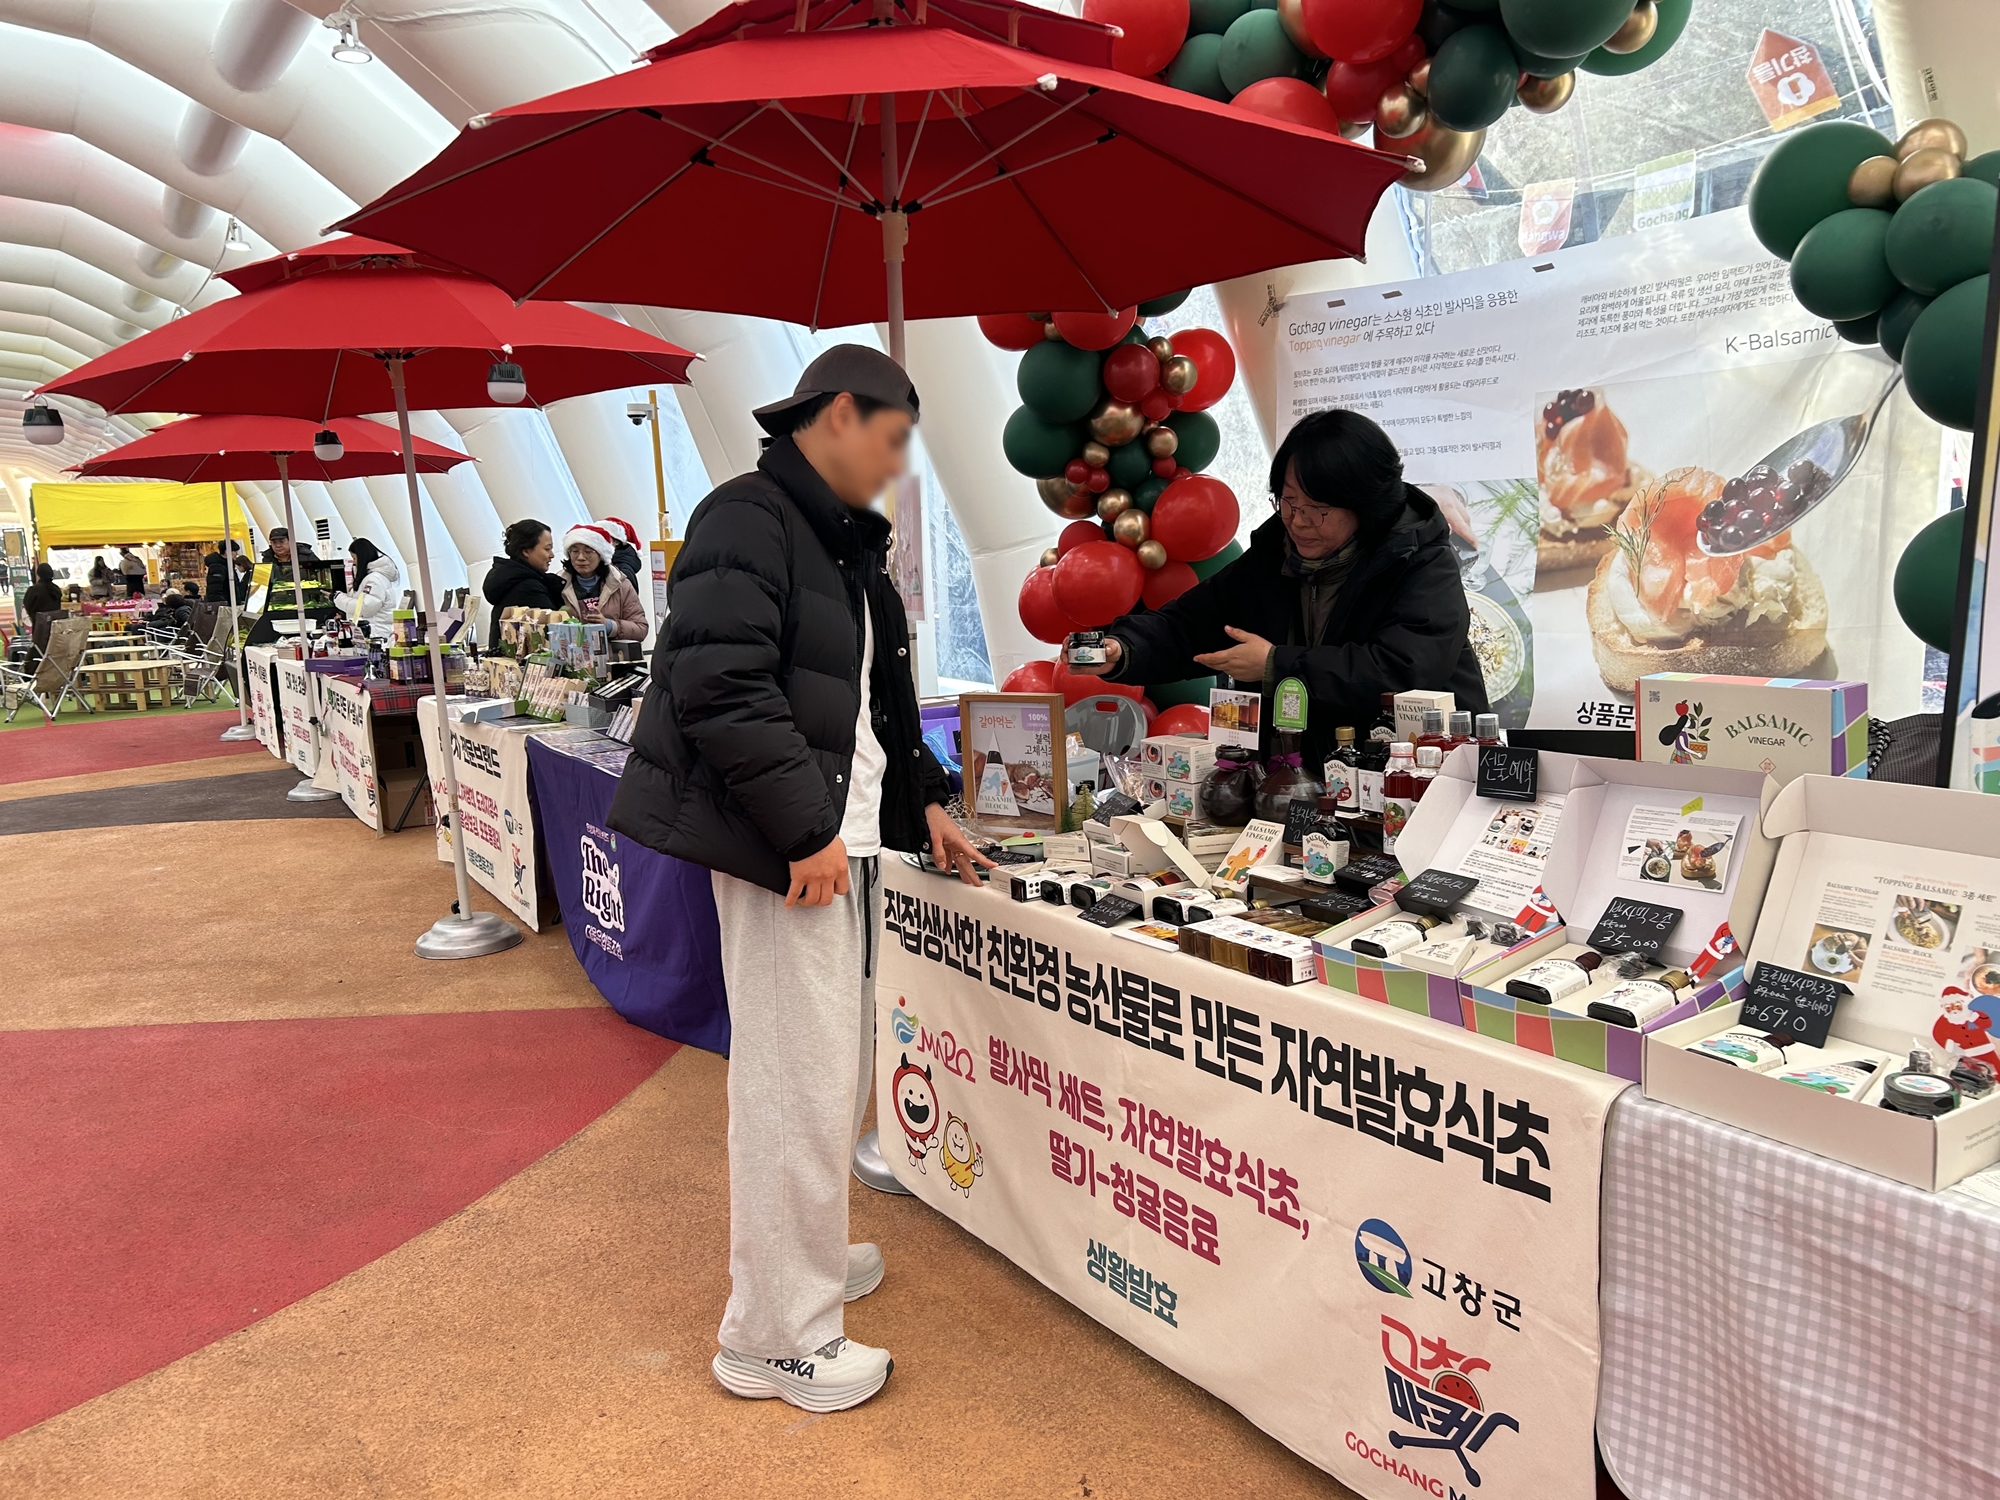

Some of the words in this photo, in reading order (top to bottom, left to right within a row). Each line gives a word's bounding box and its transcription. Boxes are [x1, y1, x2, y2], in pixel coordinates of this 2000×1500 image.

[1752, 45, 1813, 84] 참기름
[1637, 207, 1690, 229] Gochang
[1579, 304, 1600, 316] 요리에
[1688, 287, 1695, 298] 및
[1697, 285, 1713, 296] 생선
[1734, 277, 1750, 288] 야채
[1751, 274, 1767, 285] 또는
[1768, 269, 1785, 281] 과일
[1609, 286, 1637, 299] 비슷하게
[1639, 283, 1654, 295] 생긴
[1696, 271, 1719, 282] 우아한
[1722, 264, 1753, 279] 임팩트가
[1755, 260, 1771, 273] 있어
[1384, 309, 1411, 323] 소스형
[1415, 302, 1442, 319] 식초인
[1445, 295, 1485, 314] 발사믹을
[1487, 289, 1518, 307] 응용한
[1622, 309, 1643, 321] 풍미와
[1702, 294, 1725, 307] 그러나
[1727, 290, 1742, 302] 가장
[1744, 285, 1767, 298] 맛있게
[1769, 282, 1785, 293] 먹는
[1323, 333, 1361, 348] vinegar
[1363, 331, 1374, 342] 에
[1375, 325, 1413, 342] 주목하고
[1415, 321, 1435, 337] 있다
[1600, 324, 1621, 335] 치즈에
[1639, 319, 1653, 329] 먹는
[1680, 310, 1696, 321] 또한
[1725, 322, 1834, 354] K-Balsamic
[1028, 713, 1048, 722] 100%
[1398, 713, 1425, 722] VINEGA
[1577, 701, 1636, 728] 상품문
[1371, 728, 1396, 741] BALSAMIC
[1724, 713, 1814, 748] BALSAMIC
[1748, 735, 1786, 747] VINEGAR
[1326, 761, 1348, 774] BALSAMIC
[979, 795, 1014, 804] BALSAMIC
[985, 802, 1009, 810] BLOCK
[1245, 831, 1274, 843] VINEGAR
[1247, 824, 1281, 837] BALSAMIC
[1305, 834, 1331, 849] BALSAMIC
[583, 841, 609, 880] The
[584, 875, 623, 927] Right
[1826, 881, 1854, 891] BALSAMIC
[1854, 886, 1880, 896] VINEGAR
[1915, 883, 1958, 897] BALSAMIC
[1962, 890, 1975, 901] 3종
[1598, 930, 1659, 949] 35.000
[1882, 943, 1913, 956] BALSAMIC
[1912, 950, 1933, 959] BLOCK
[987, 924, 1060, 1013] 친환경
[1065, 951, 1185, 1062] 농산물로
[1190, 994, 1264, 1094] 만든
[1271, 1022, 1552, 1204] 자연발효식초
[989, 1034, 1052, 1109] 발사믹
[1058, 1070, 1113, 1142] 세트,
[1118, 1096, 1310, 1241] 자연발효식초,
[1050, 1129, 1221, 1266] 딸기-청귤음료
[1086, 1237, 1178, 1329] 생활발효
[1421, 1257, 1523, 1333] 고창군
[1345, 1431, 1444, 1498] GOCHANG
